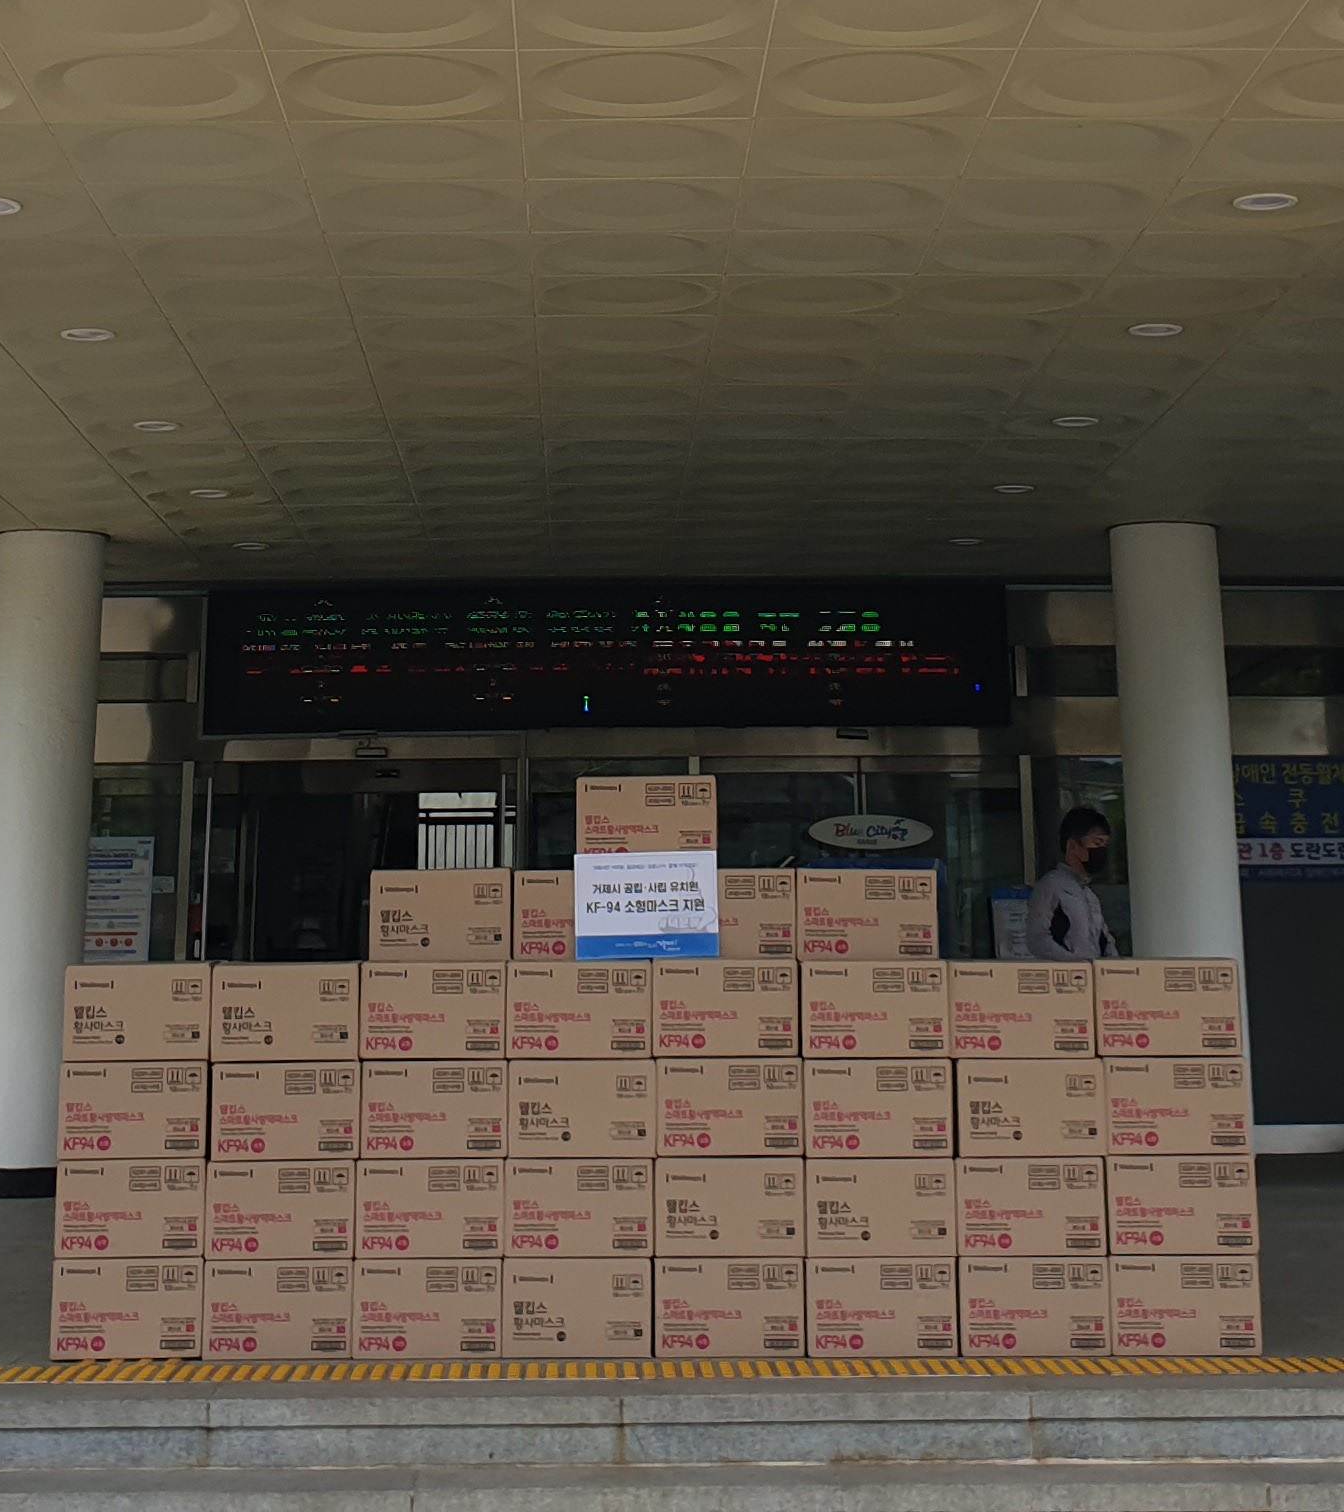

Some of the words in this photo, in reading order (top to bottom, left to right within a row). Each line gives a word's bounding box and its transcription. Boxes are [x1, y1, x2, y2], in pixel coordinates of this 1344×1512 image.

[834, 823, 865, 837] Blue
[866, 825, 892, 839] City
[1259, 843, 1285, 861] 1층
[592, 884, 621, 894] 거제시
[670, 881, 699, 892] 유치원
[586, 902, 621, 914] KF-94
[624, 900, 680, 913] 소형마스크
[683, 898, 705, 912] 지원
[519, 941, 551, 957] KF94
[802, 939, 834, 955] KF94
[365, 1036, 397, 1052] KF94
[511, 1035, 543, 1051] KF94
[658, 1033, 690, 1049] KF94
[809, 1035, 841, 1051] KF94
[954, 1035, 986, 1051] KF94
[1102, 1033, 1134, 1049] KF94
[63, 1136, 95, 1152] KF94
[217, 1138, 249, 1154] KF94
[366, 1136, 398, 1152] KF94
[663, 1133, 695, 1149] KF94
[812, 1135, 844, 1151] KF94
[1111, 1131, 1143, 1147] KF94
[60, 1235, 92, 1251] KF94
[211, 1237, 243, 1253] KF94
[361, 1236, 393, 1252] KF94
[511, 1234, 543, 1250] KF94
[964, 1233, 996, 1249] KF94
[1116, 1231, 1148, 1247] KF94
[56, 1337, 88, 1353] KF94
[209, 1337, 241, 1353] KF94
[358, 1336, 390, 1352] KF94
[661, 1334, 693, 1350] KF94
[815, 1334, 847, 1350] KF94
[968, 1334, 1000, 1350] KF94
[1117, 1332, 1149, 1348] KF94
